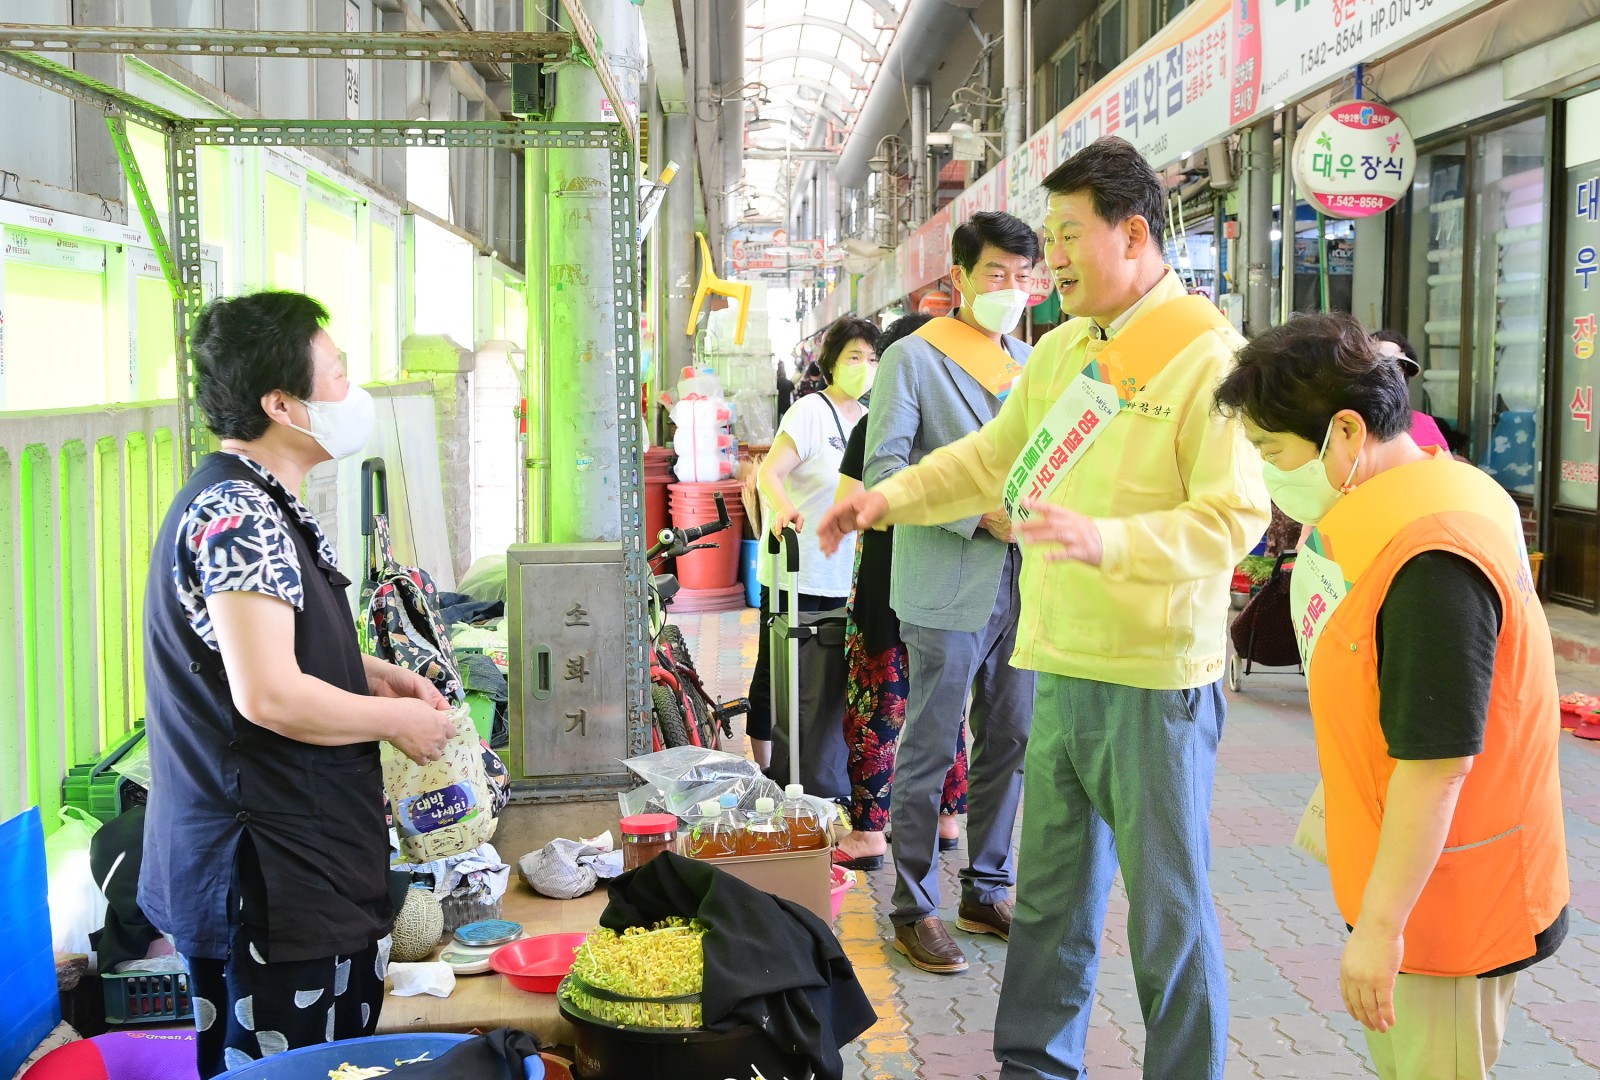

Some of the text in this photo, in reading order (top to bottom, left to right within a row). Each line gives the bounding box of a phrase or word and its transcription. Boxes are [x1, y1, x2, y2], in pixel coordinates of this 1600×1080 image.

[1301, 20, 1363, 76] T.542-8564
[1338, 113, 1360, 123] 반송2동
[1326, 195, 1384, 208] T.542-8564
[564, 602, 590, 736] 소화기
[416, 792, 446, 811] 대박
[431, 801, 467, 819] 나세요!
